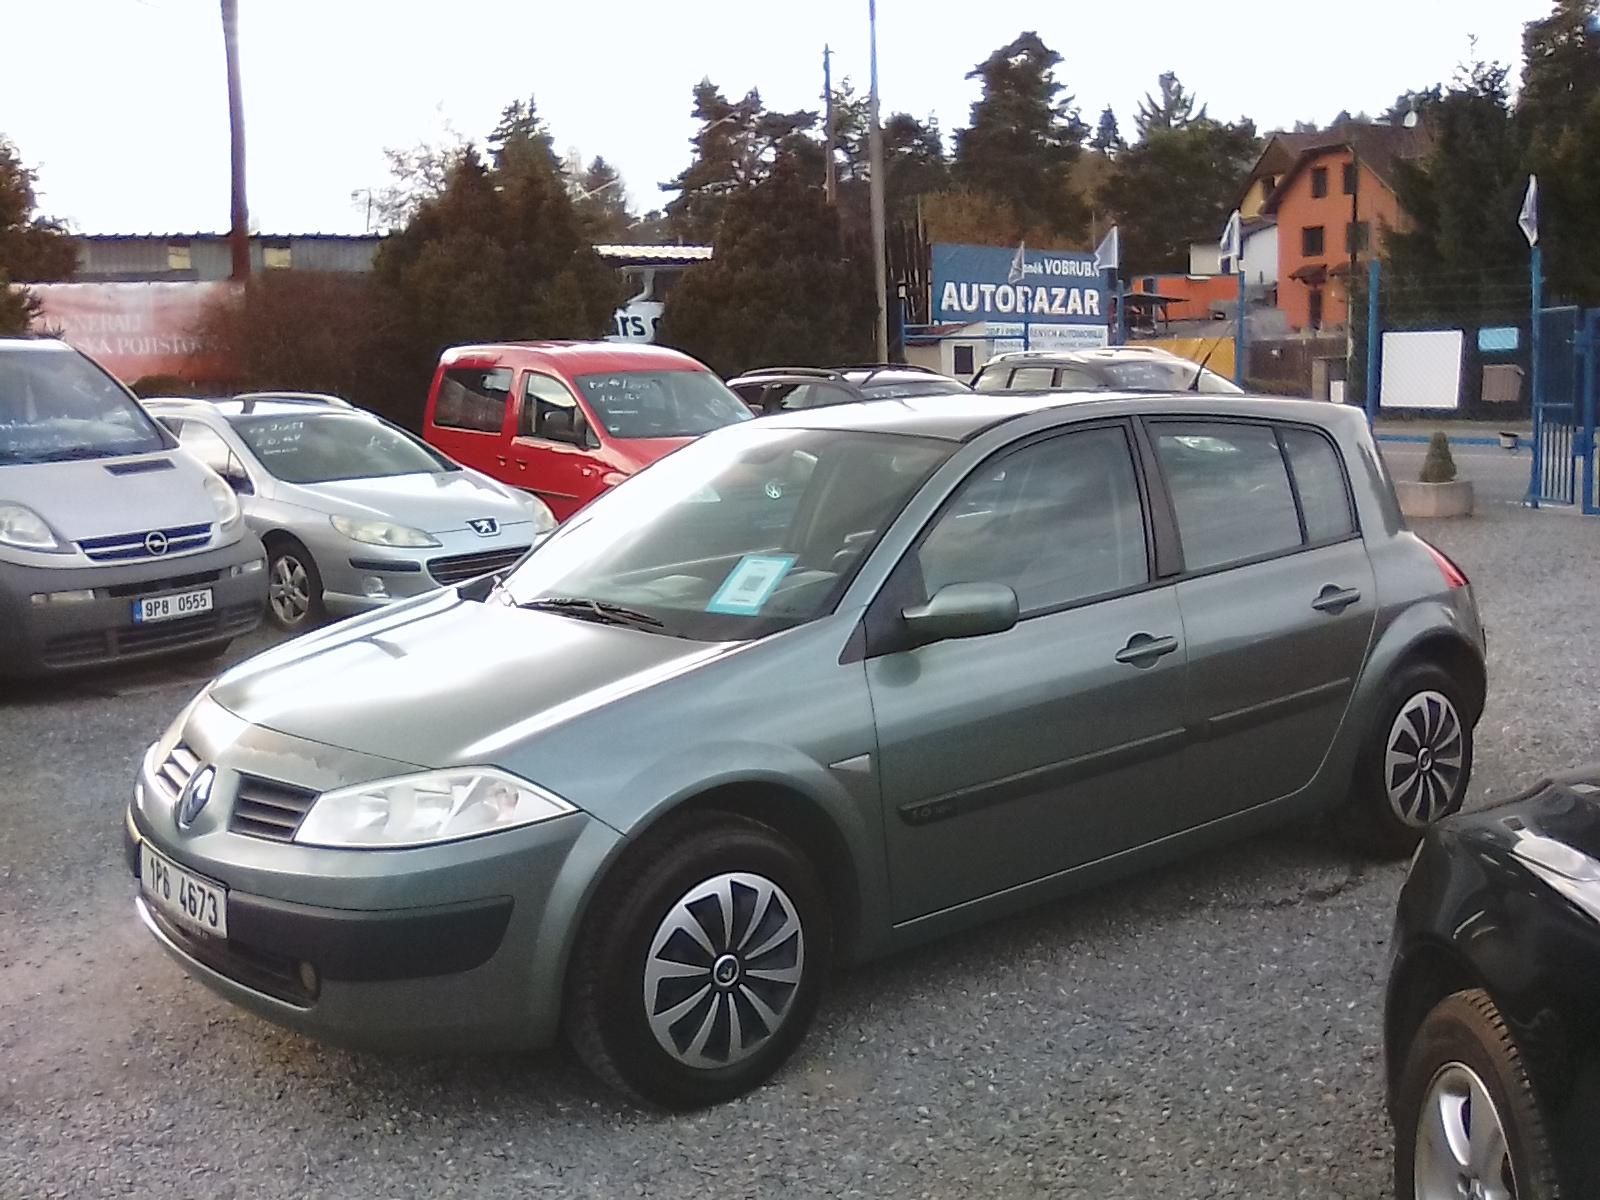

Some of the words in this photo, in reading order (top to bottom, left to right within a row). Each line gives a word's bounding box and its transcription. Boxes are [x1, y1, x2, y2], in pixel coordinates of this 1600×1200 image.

[941, 282, 1100, 316] AUTOBAZAR
[145, 600, 169, 617] 9P8
[178, 592, 207, 611] 0555
[179, 877, 218, 927] 4673
